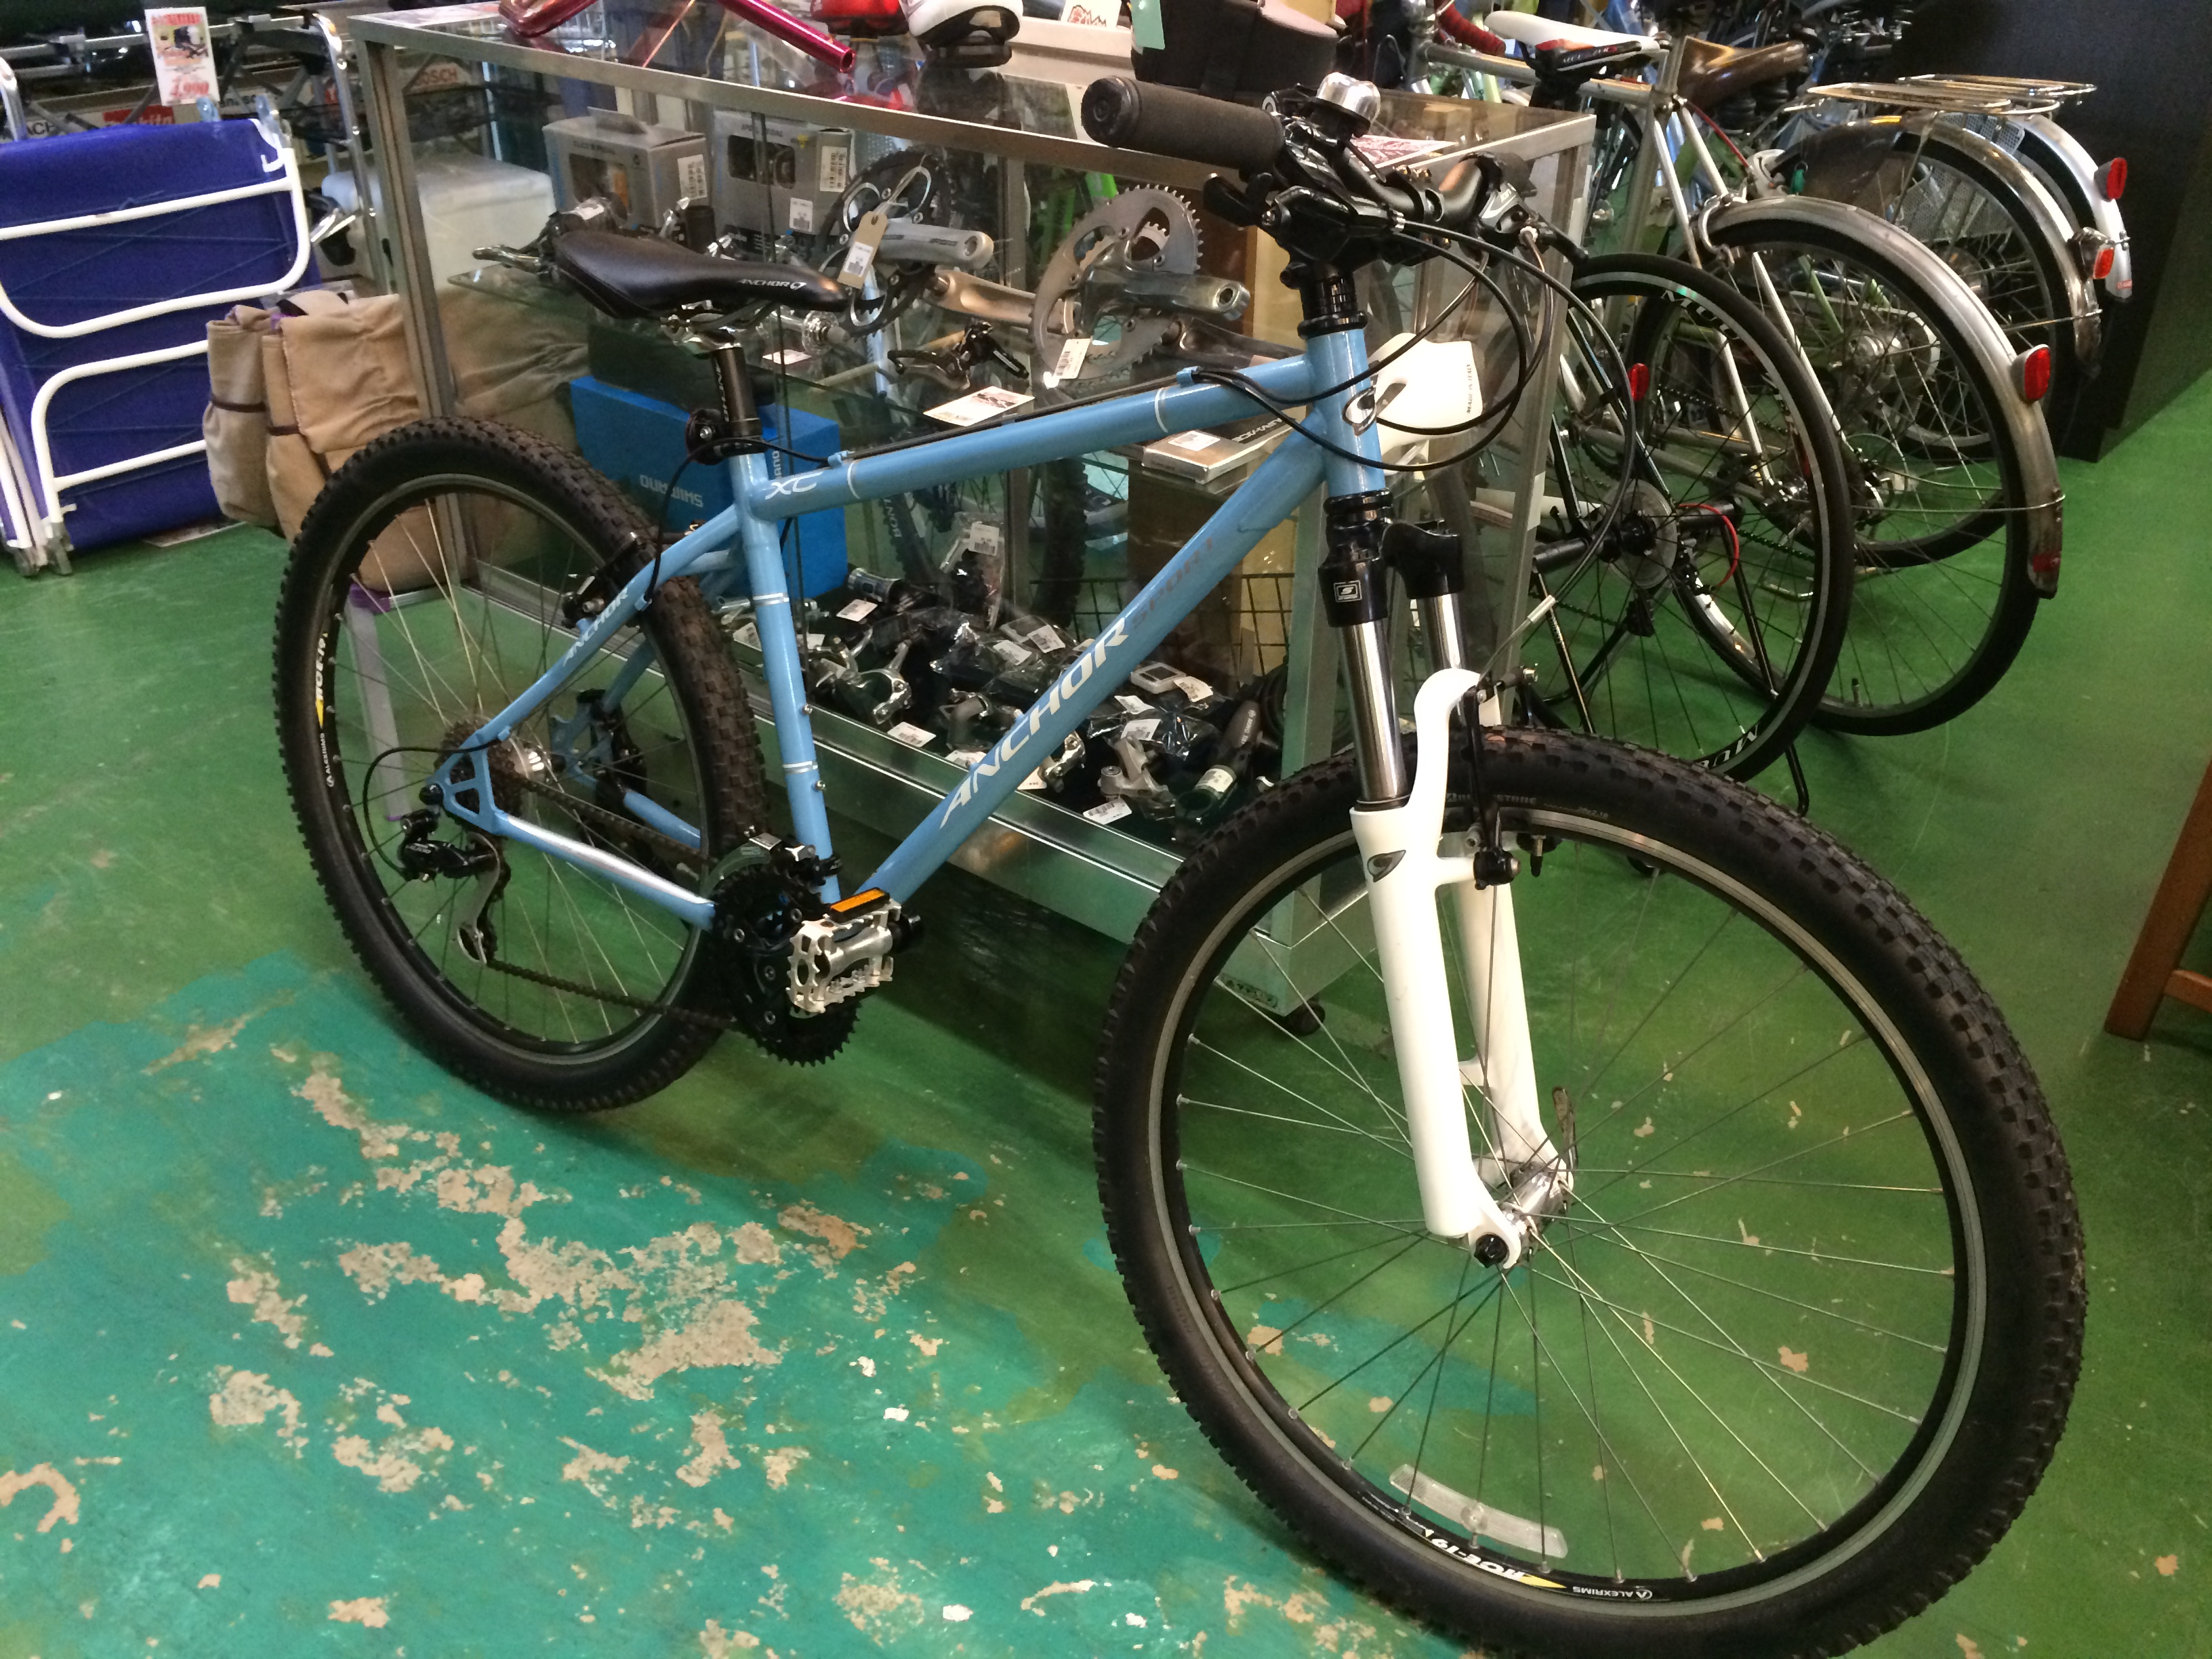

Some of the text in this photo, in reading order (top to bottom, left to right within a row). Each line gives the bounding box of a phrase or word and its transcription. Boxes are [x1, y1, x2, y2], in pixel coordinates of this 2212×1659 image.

[737, 279, 790, 287] ANCHOR
[639, 474, 703, 508] SHIMANO
[563, 587, 628, 667] ANCHOR
[940, 617, 1128, 829] ANCHOR
[1572, 1586, 1633, 1597] ALEXRIMS
